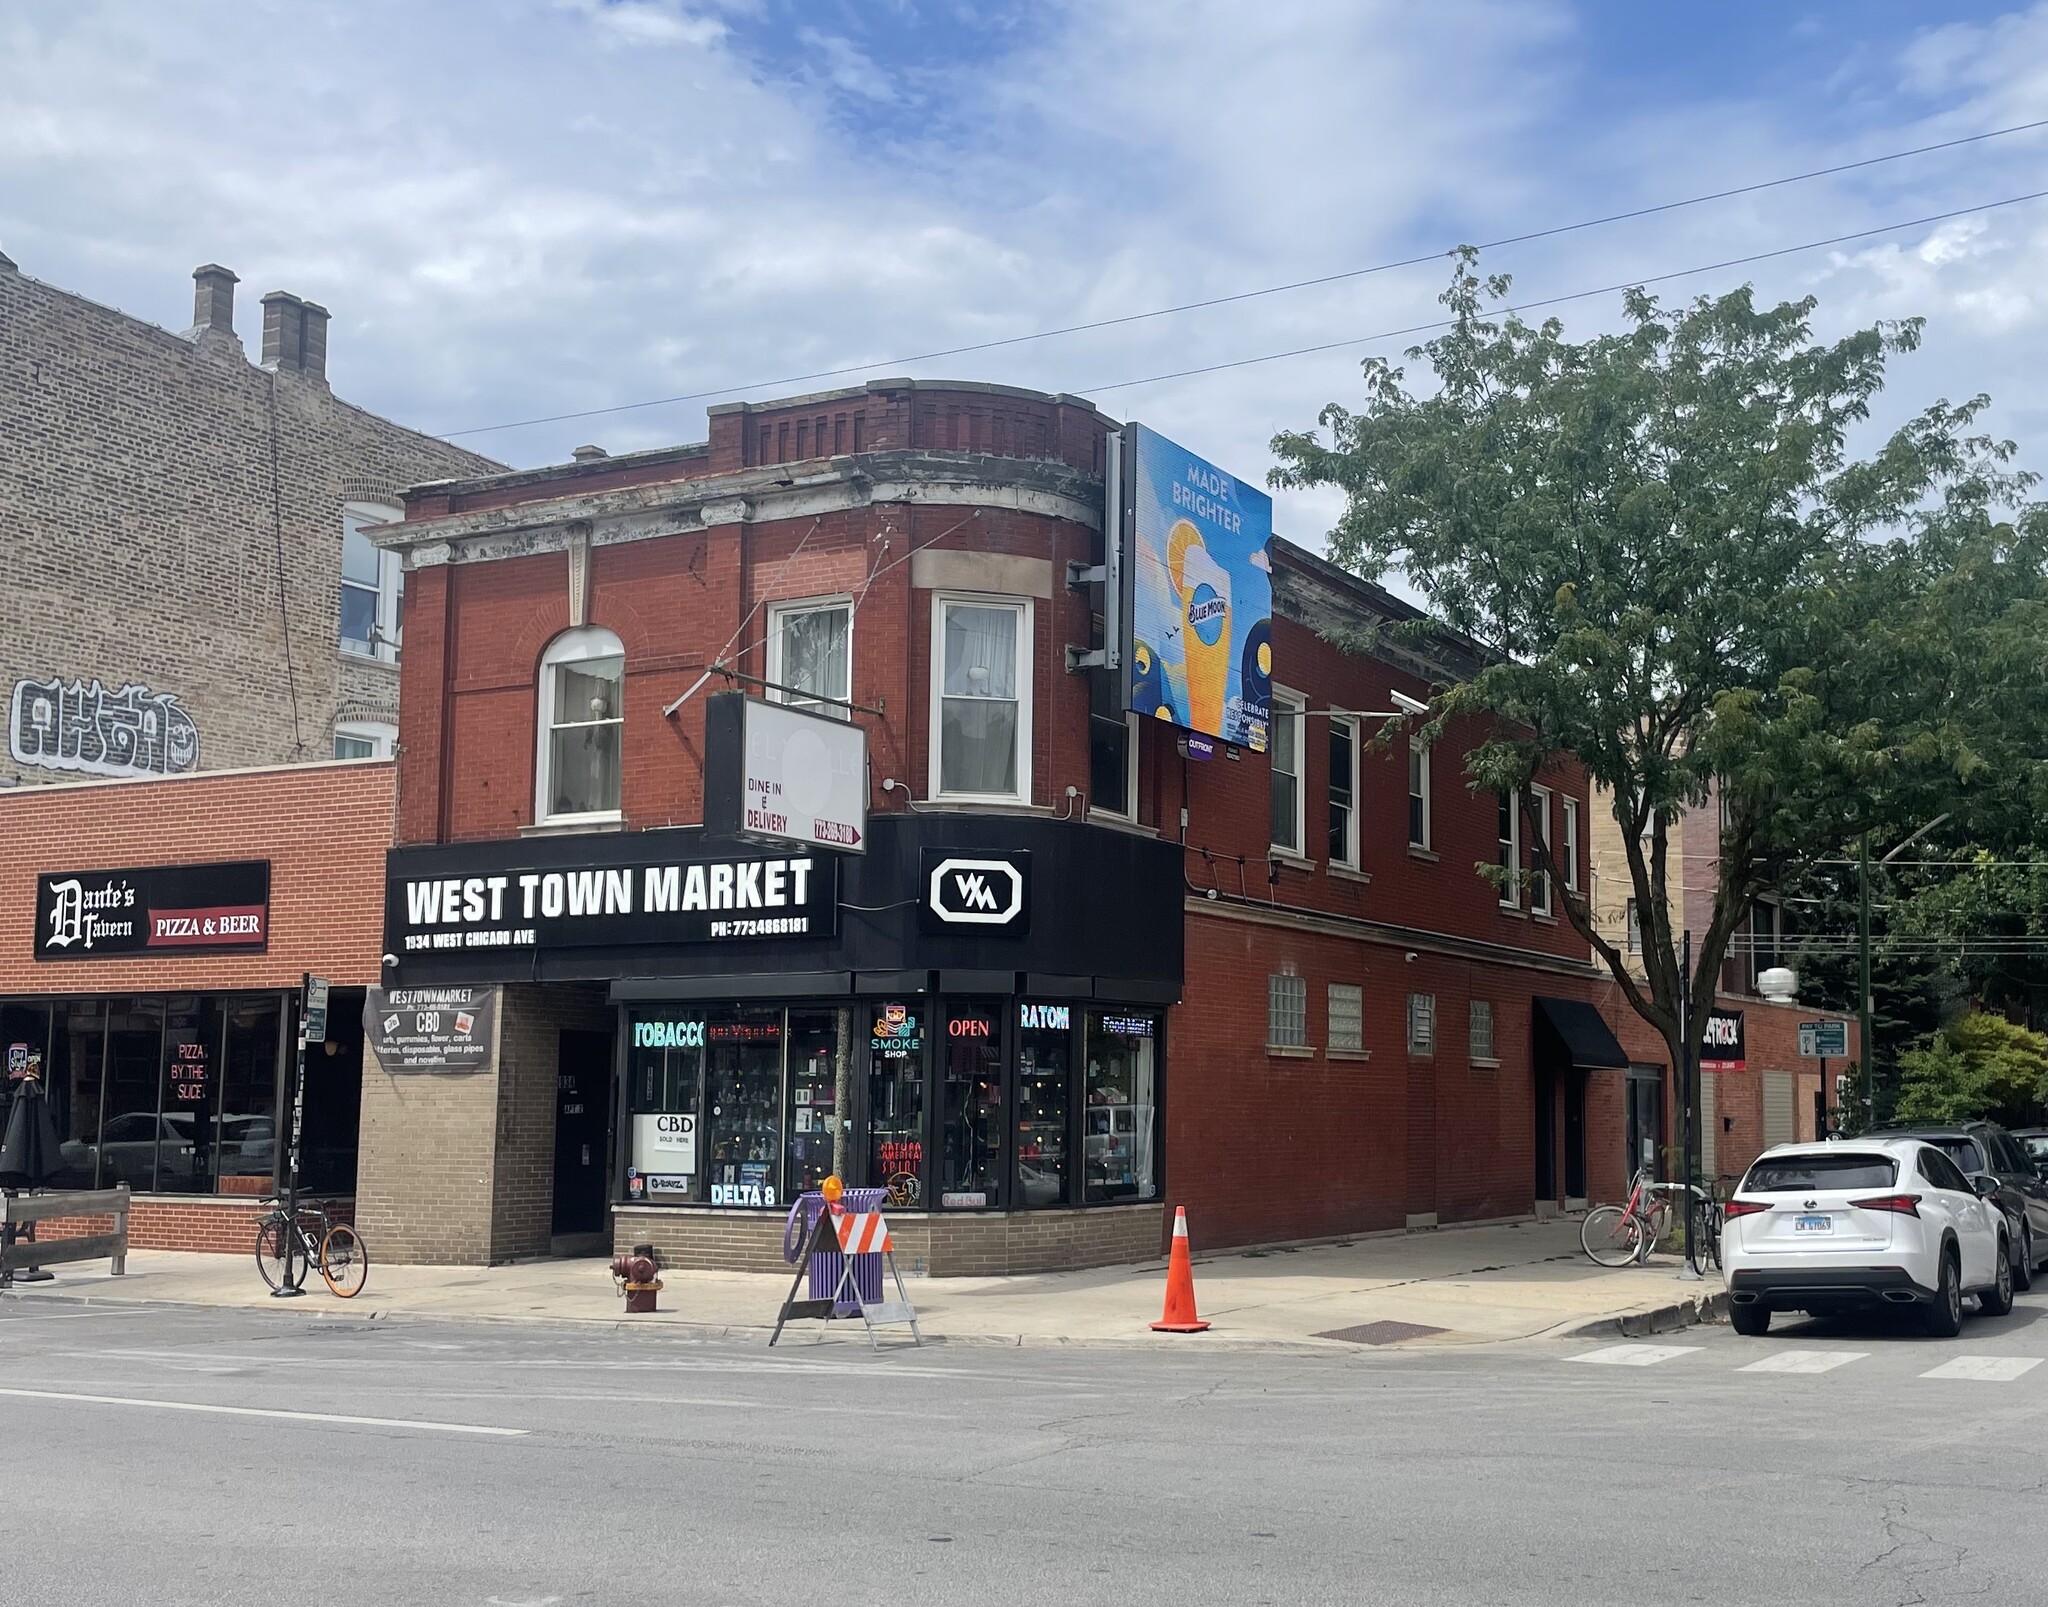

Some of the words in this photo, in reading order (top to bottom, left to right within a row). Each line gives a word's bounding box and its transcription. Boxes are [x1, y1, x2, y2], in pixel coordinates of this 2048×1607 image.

[1188, 463, 1228, 500] MADE
[1173, 481, 1242, 535] BRIGHTER
[1237, 698, 1269, 718] CELEBRATE
[748, 778, 770, 793] DINE
[773, 783, 782, 795] IN
[748, 809, 788, 833] DELIVERY
[407, 877, 508, 924] WEST
[519, 868, 633, 919] TOWN
[644, 858, 813, 912] MARKET
[46, 879, 135, 948] Dante's
[82, 912, 133, 949] Tavern
[156, 917, 200, 937] PIZZA
[203, 917, 216, 936] &
[219, 914, 260, 935] BEER
[405, 934, 431, 950] 1934
[432, 933, 463, 948] WEST
[465, 930, 511, 946] CHICAGO
[513, 929, 536, 944] AVE
[416, 1011, 440, 1033] CBD
[949, 1019, 989, 1037] OPEN
[179, 1044, 203, 1059] PIZZA
[464, 1045, 484, 1054] pipes
[871, 1038, 920, 1050] SMOKE
[884, 1050, 907, 1058] SHOP
[171, 1065, 184, 1079] BY
[187, 1065, 204, 1079] THE
[178, 1084, 203, 1099] SLICE
[657, 1116, 694, 1133] CBD
[711, 1184, 762, 1206] DELTA
[764, 1185, 775, 1206] 8
[943, 1195, 964, 1206] Red
[966, 1195, 985, 1206] Bull
